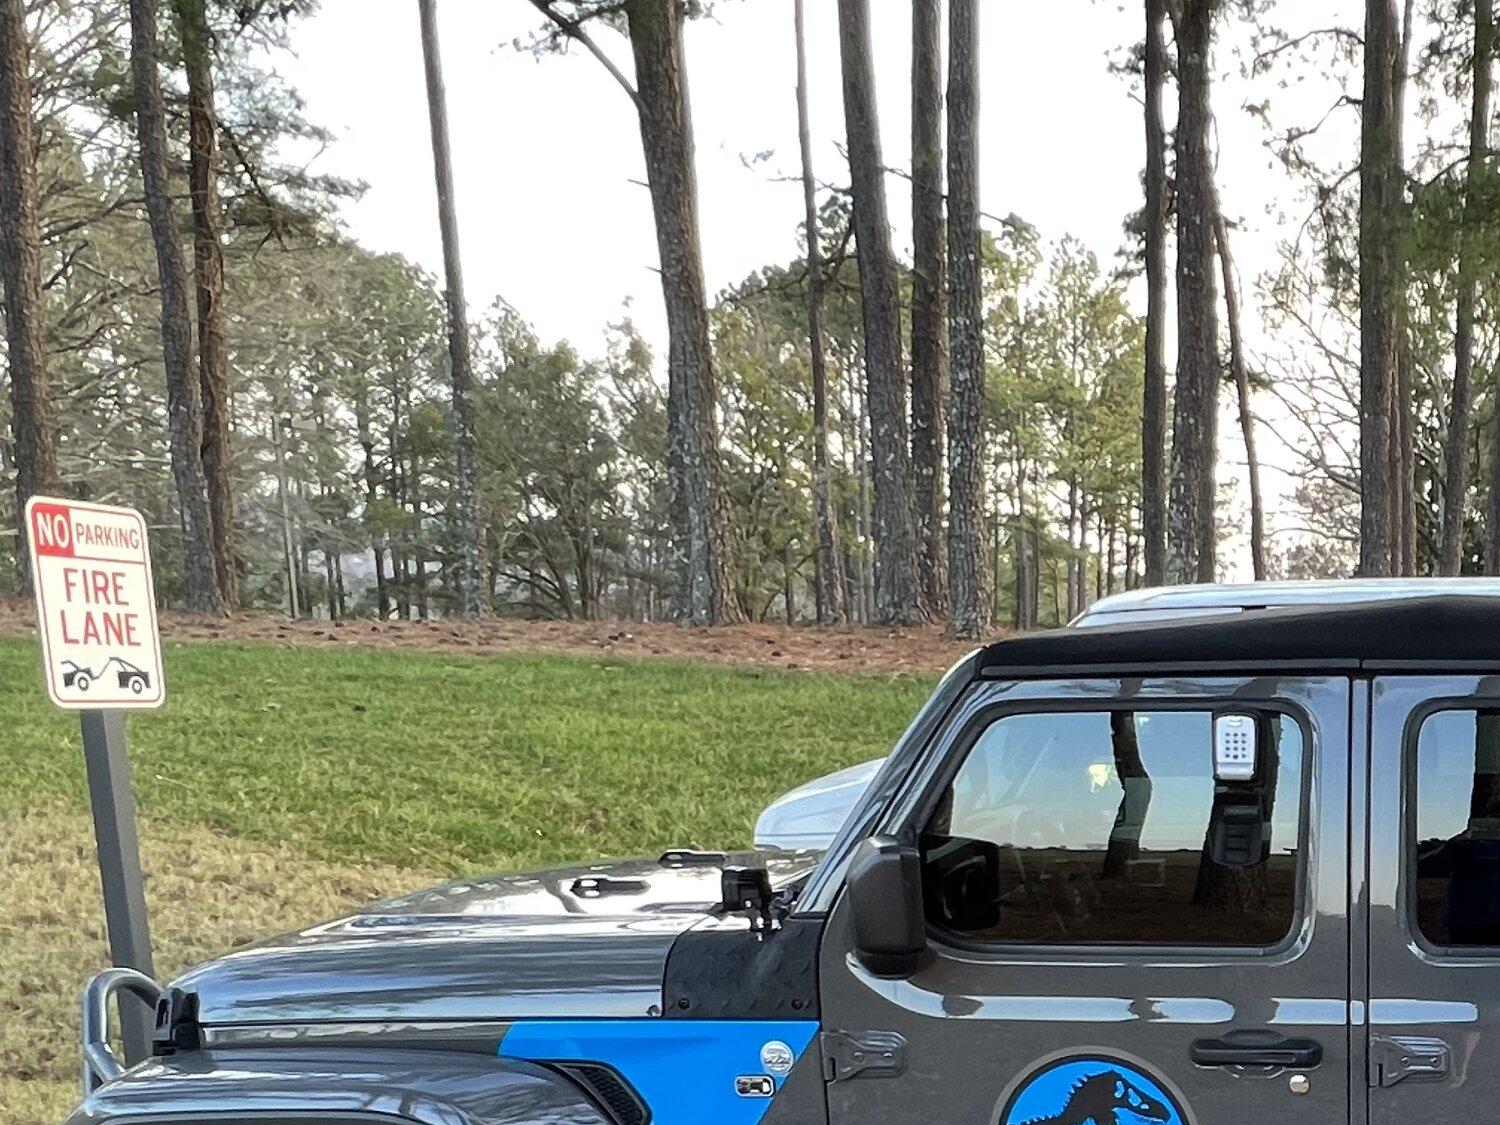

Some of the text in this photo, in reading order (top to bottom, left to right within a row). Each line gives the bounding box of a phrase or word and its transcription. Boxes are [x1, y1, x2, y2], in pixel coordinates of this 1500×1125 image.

[35, 511, 140, 550] NO PARKING
[63, 567, 129, 606] FIRE
[60, 609, 141, 647] LANE
